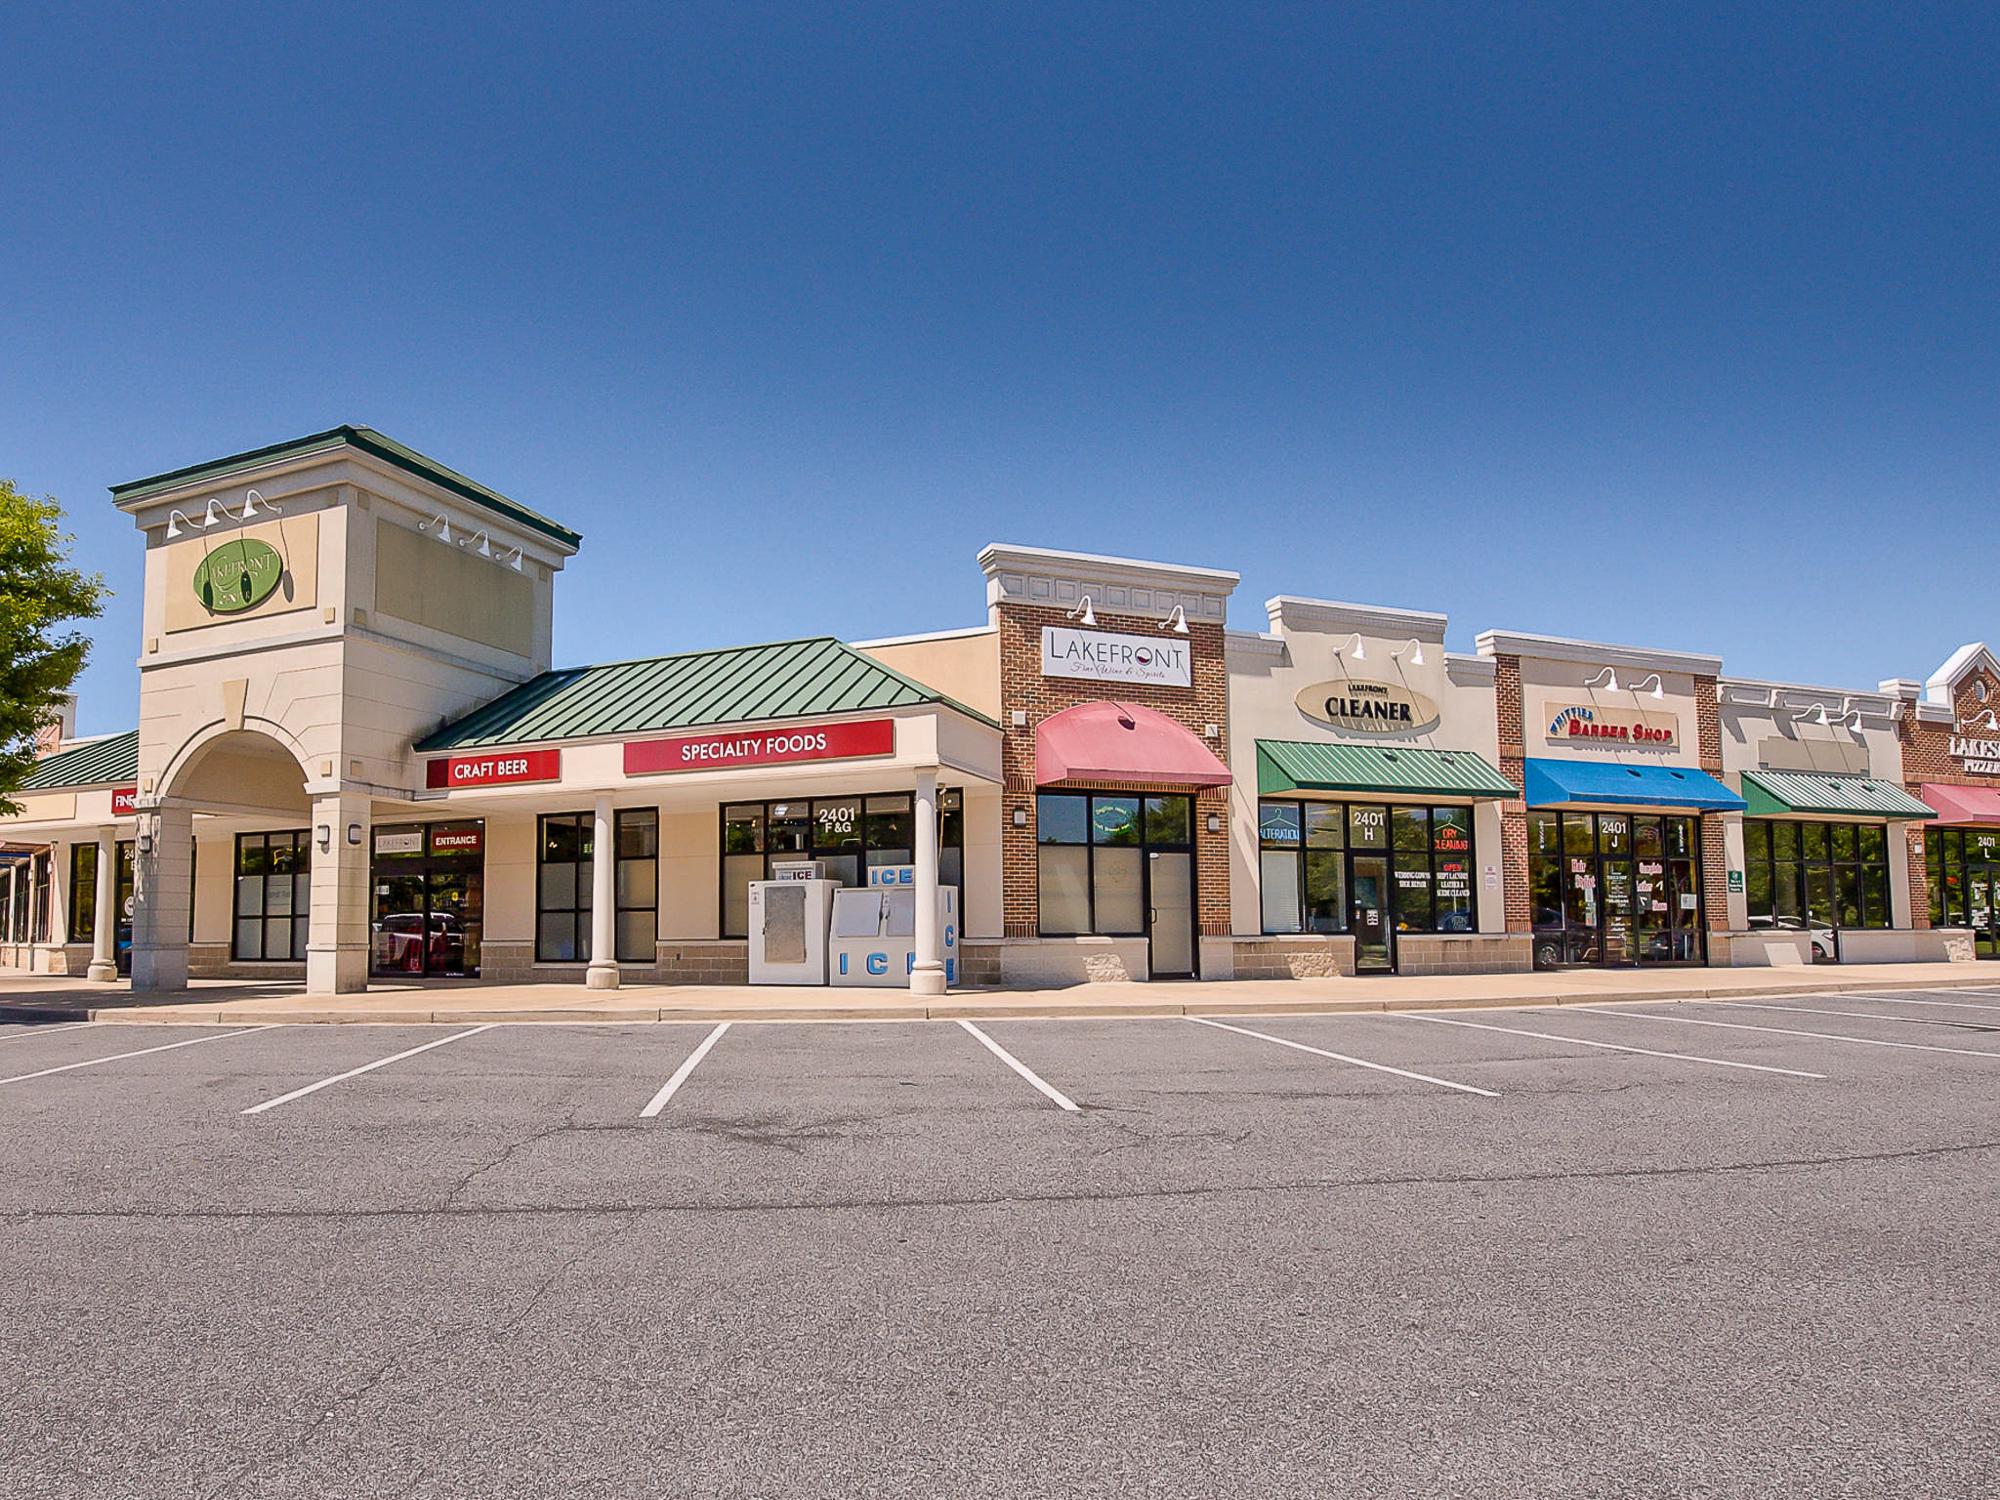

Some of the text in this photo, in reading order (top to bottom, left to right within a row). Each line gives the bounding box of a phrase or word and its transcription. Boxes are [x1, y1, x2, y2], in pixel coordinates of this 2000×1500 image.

[1051, 631, 1183, 669] LAKEFRONT
[1325, 697, 1413, 722] CLEANER
[1632, 724, 1672, 742] SHOP
[681, 733, 828, 762] SPECIALTY FOODS
[454, 759, 529, 779] CRAFT BEER
[819, 808, 856, 824] 2401
[1354, 811, 1385, 826] 2401
[1364, 828, 1374, 841] H
[1602, 821, 1627, 834] 2401
[435, 835, 477, 846] ENTRANCE
[1611, 835, 1618, 848] J
[1978, 836, 1996, 847] 2401
[1984, 848, 1991, 859] L
[793, 871, 813, 881] ICE
[872, 868, 914, 885] ICE
